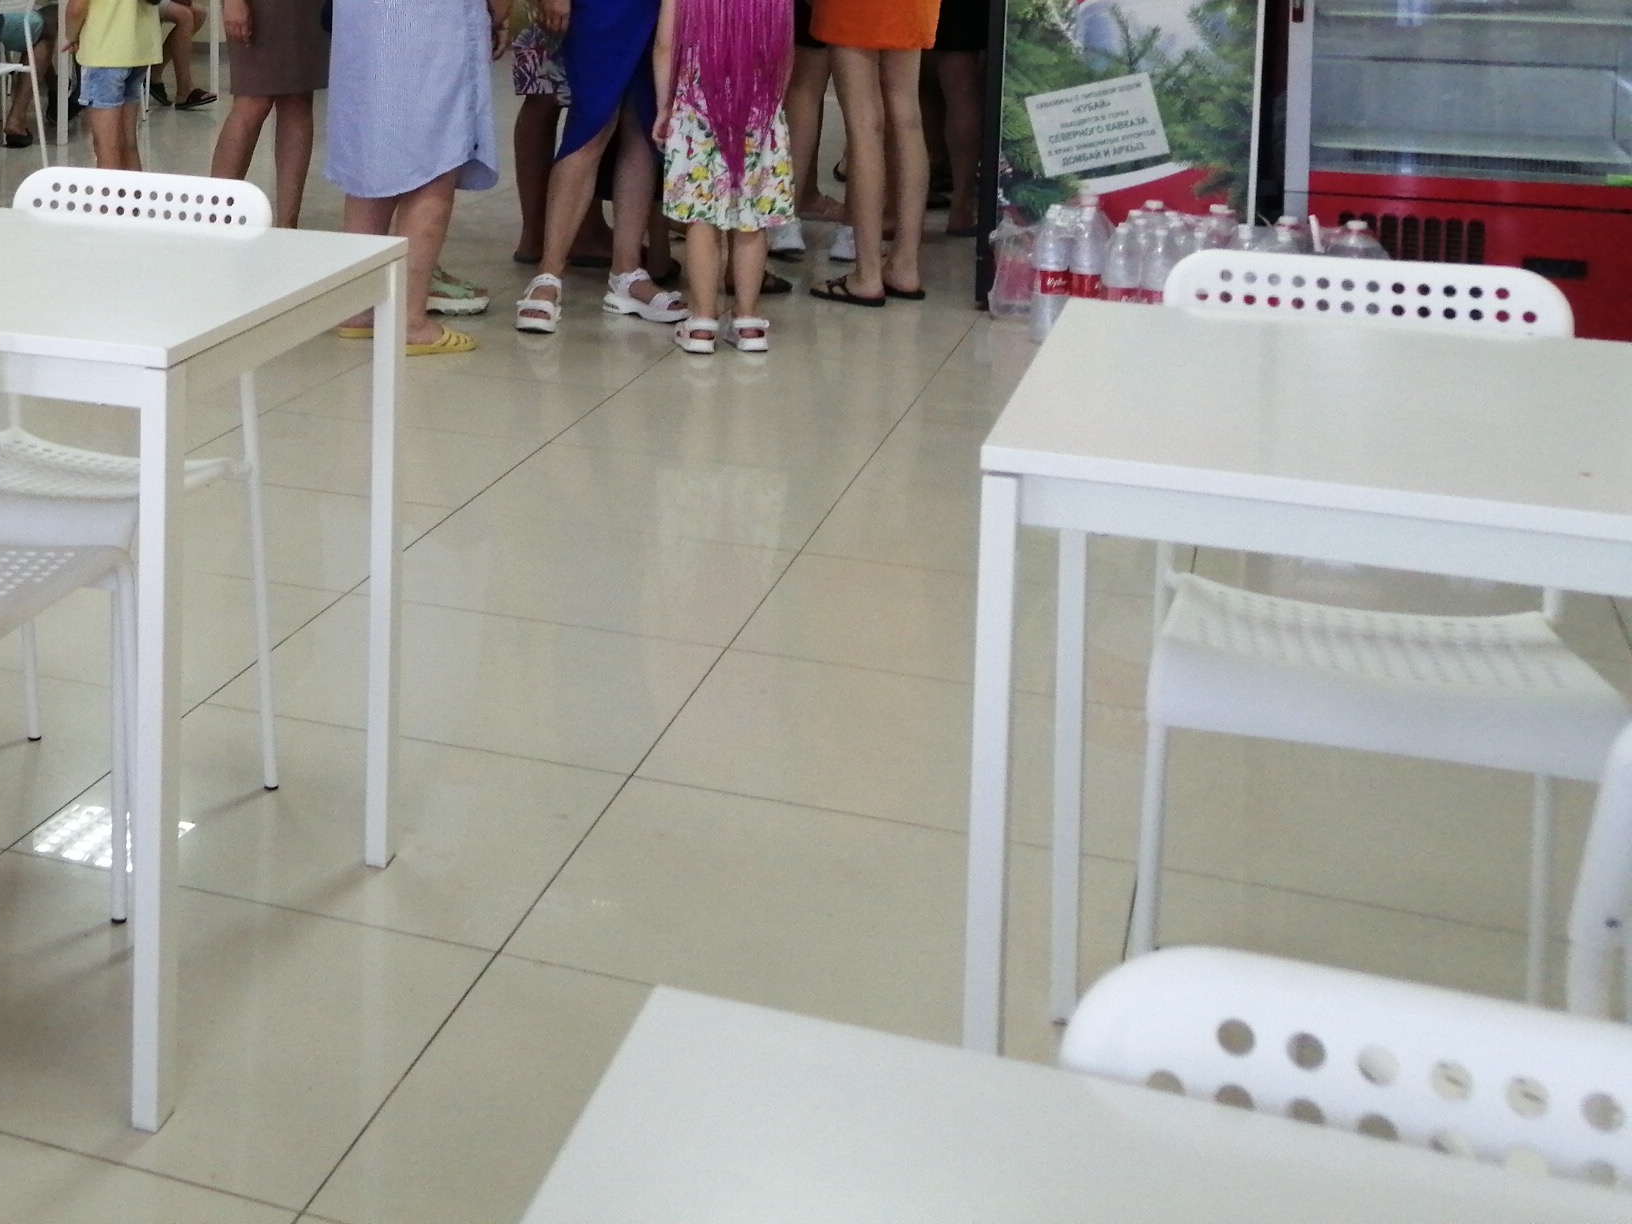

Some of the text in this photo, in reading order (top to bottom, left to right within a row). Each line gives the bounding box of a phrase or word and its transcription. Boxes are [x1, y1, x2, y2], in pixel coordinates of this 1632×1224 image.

[1048, 116, 1148, 144] СЕВЕРНОГО КАВКАЗА
[1062, 149, 1101, 167] ДОМБАЙ
[1104, 148, 1111, 157] И
